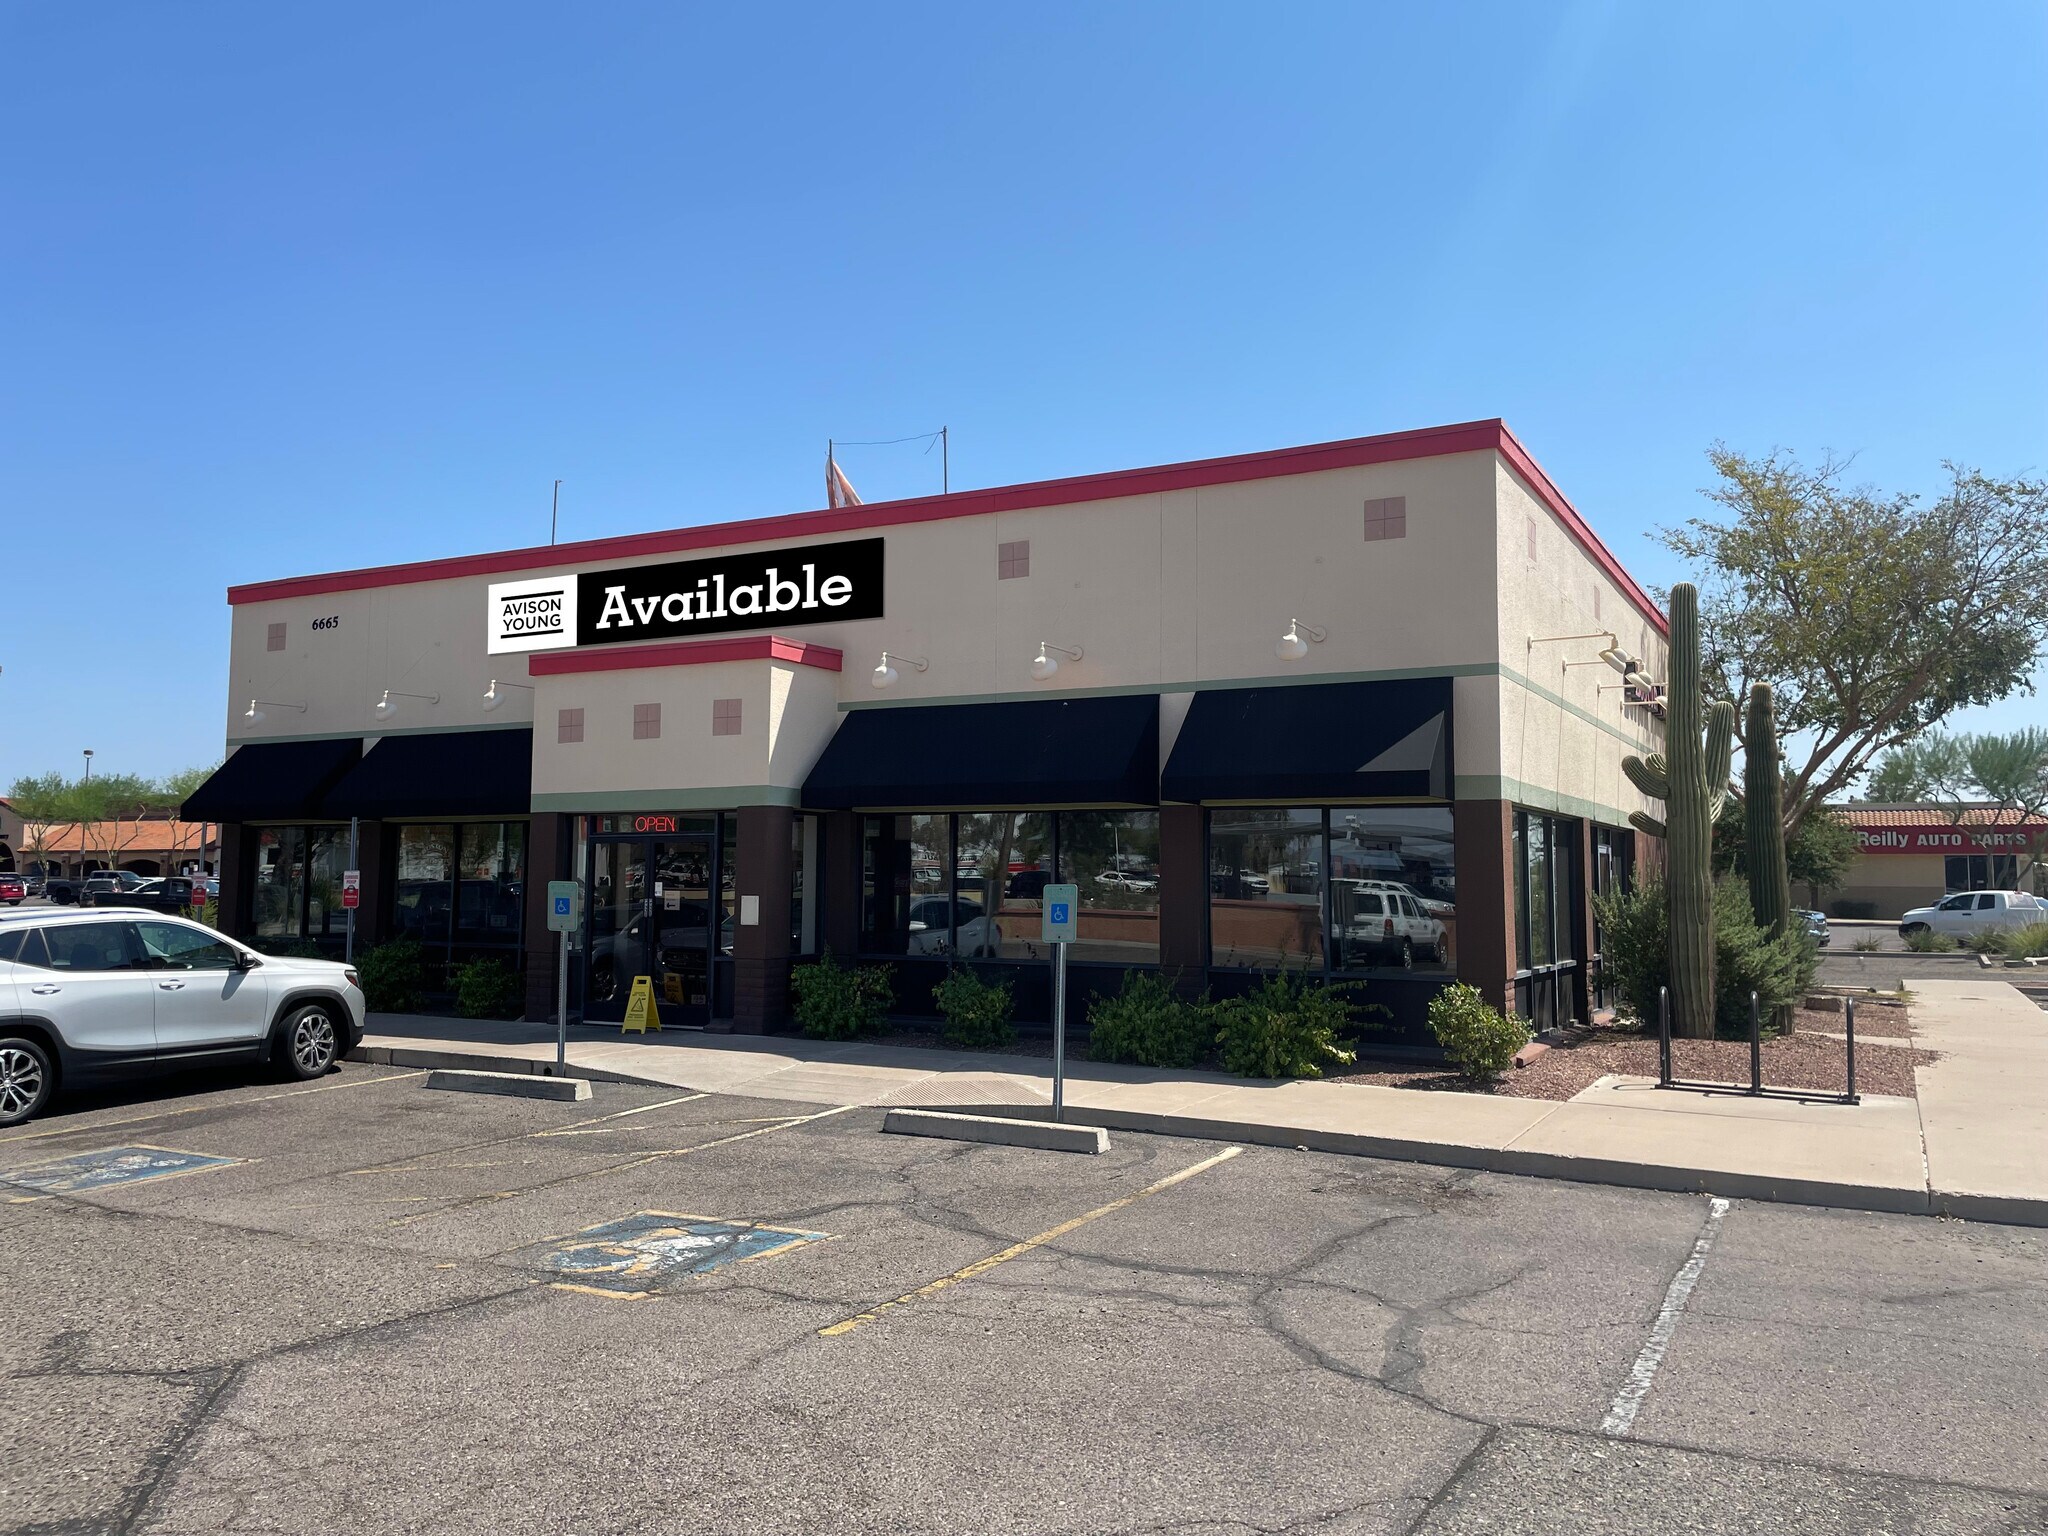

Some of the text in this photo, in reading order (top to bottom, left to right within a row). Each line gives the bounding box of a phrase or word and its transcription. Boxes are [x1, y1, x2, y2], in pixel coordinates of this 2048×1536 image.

[596, 563, 853, 629] Available
[503, 598, 561, 616] AVISON
[312, 616, 339, 630] 6665
[503, 614, 561, 631] YOUNG
[635, 816, 675, 832] OPEN
[1917, 834, 1962, 846] AUTO
